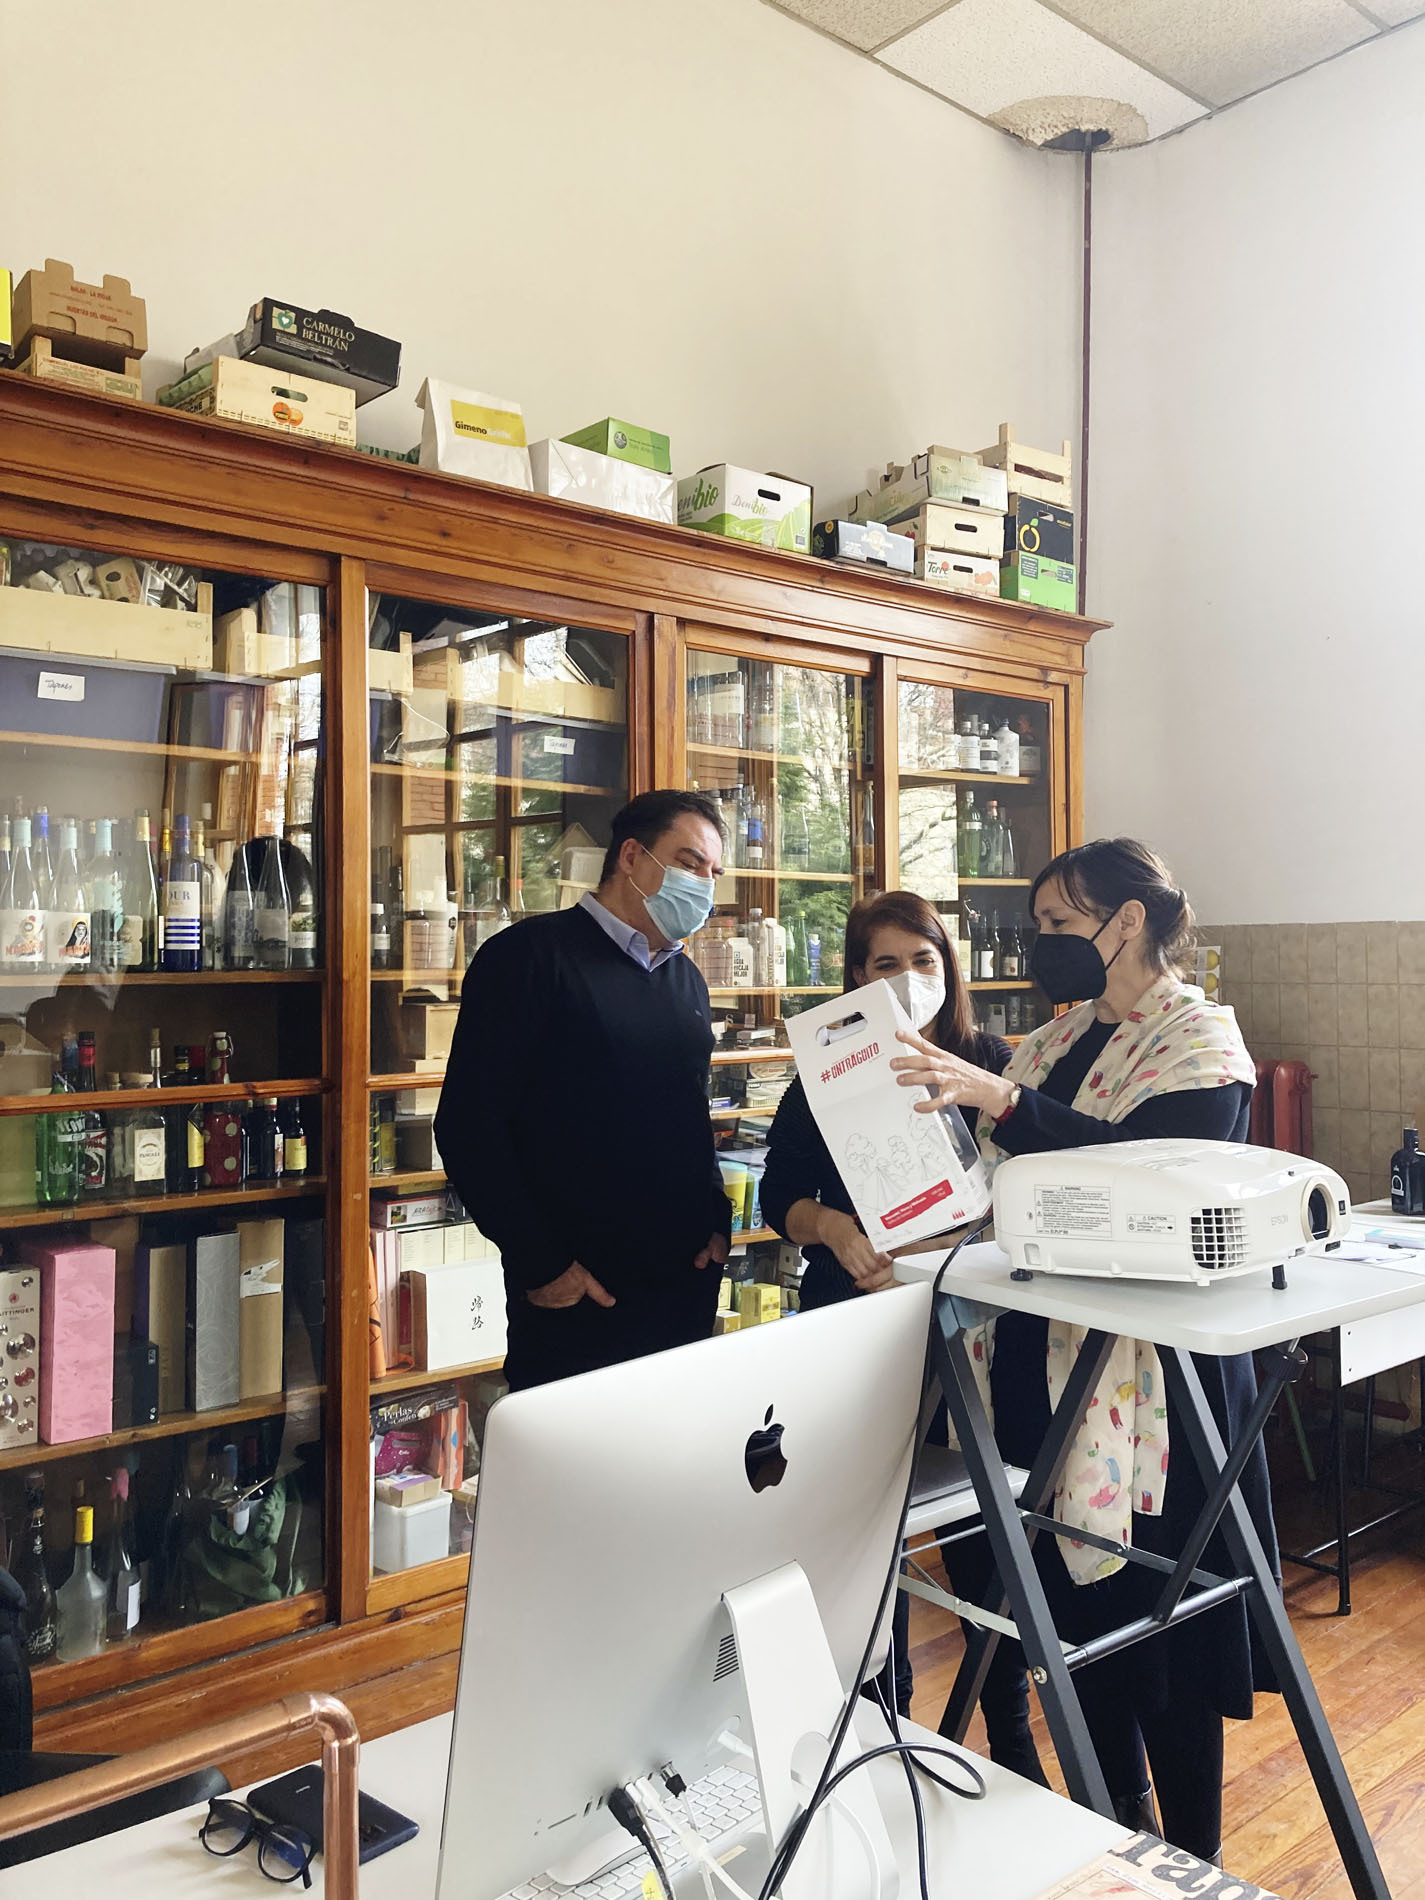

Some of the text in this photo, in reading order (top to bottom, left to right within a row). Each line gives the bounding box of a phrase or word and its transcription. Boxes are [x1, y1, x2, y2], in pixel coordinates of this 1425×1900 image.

[302, 328, 349, 352] BELTRÁN
[303, 317, 355, 342] CARMELO
[455, 420, 488, 435] Gimeno
[820, 1041, 880, 1084] #UNTRAGUITO
[383, 1406, 413, 1422] Perlas
